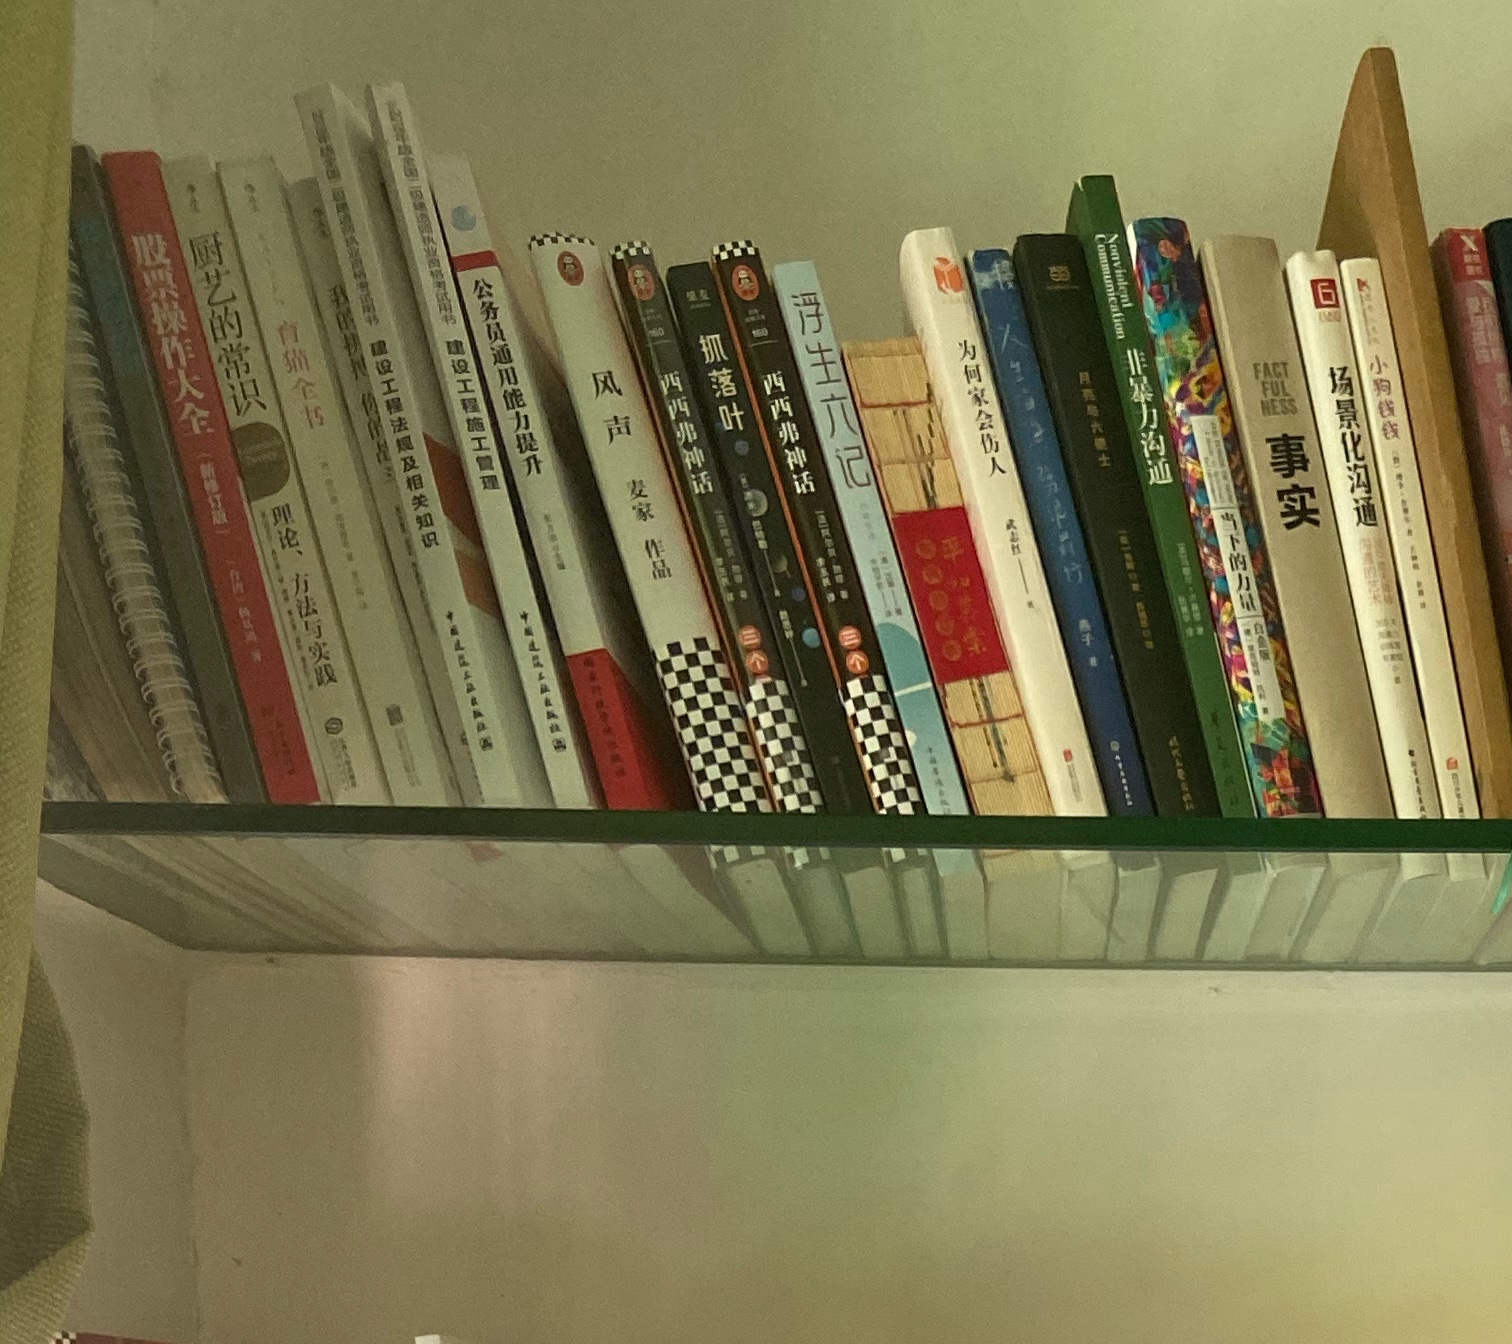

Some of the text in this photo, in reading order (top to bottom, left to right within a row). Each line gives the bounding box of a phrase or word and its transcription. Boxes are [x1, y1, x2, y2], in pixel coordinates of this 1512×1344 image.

[132, 233, 212, 435] 股票操作大全
[189, 230, 267, 417] 厨艺的常识
[471, 277, 544, 477] 公务员通用能力提升
[698, 333, 747, 432] 抓落叶
[1253, 360, 1290, 381] FACT
[1260, 379, 1292, 399] FUL
[369, 339, 440, 549] 建设工程法规及相关知识
[445, 339, 502, 491] 建设工程施工管理
[591, 369, 633, 446] 风声
[660, 370, 713, 494] 西西弗神话
[762, 370, 816, 495] 西西弗神话
[791, 291, 872, 489] 浮生六记
[957, 339, 1008, 478] 为何家会伤人
[1126, 348, 1174, 487] 非暴力沟通
[1327, 365, 1379, 529] 场景化沟通
[1368, 354, 1399, 441] 小狗钱钱
[1264, 432, 1321, 532] 事实
[1219, 511, 1258, 612] 当下的力量
